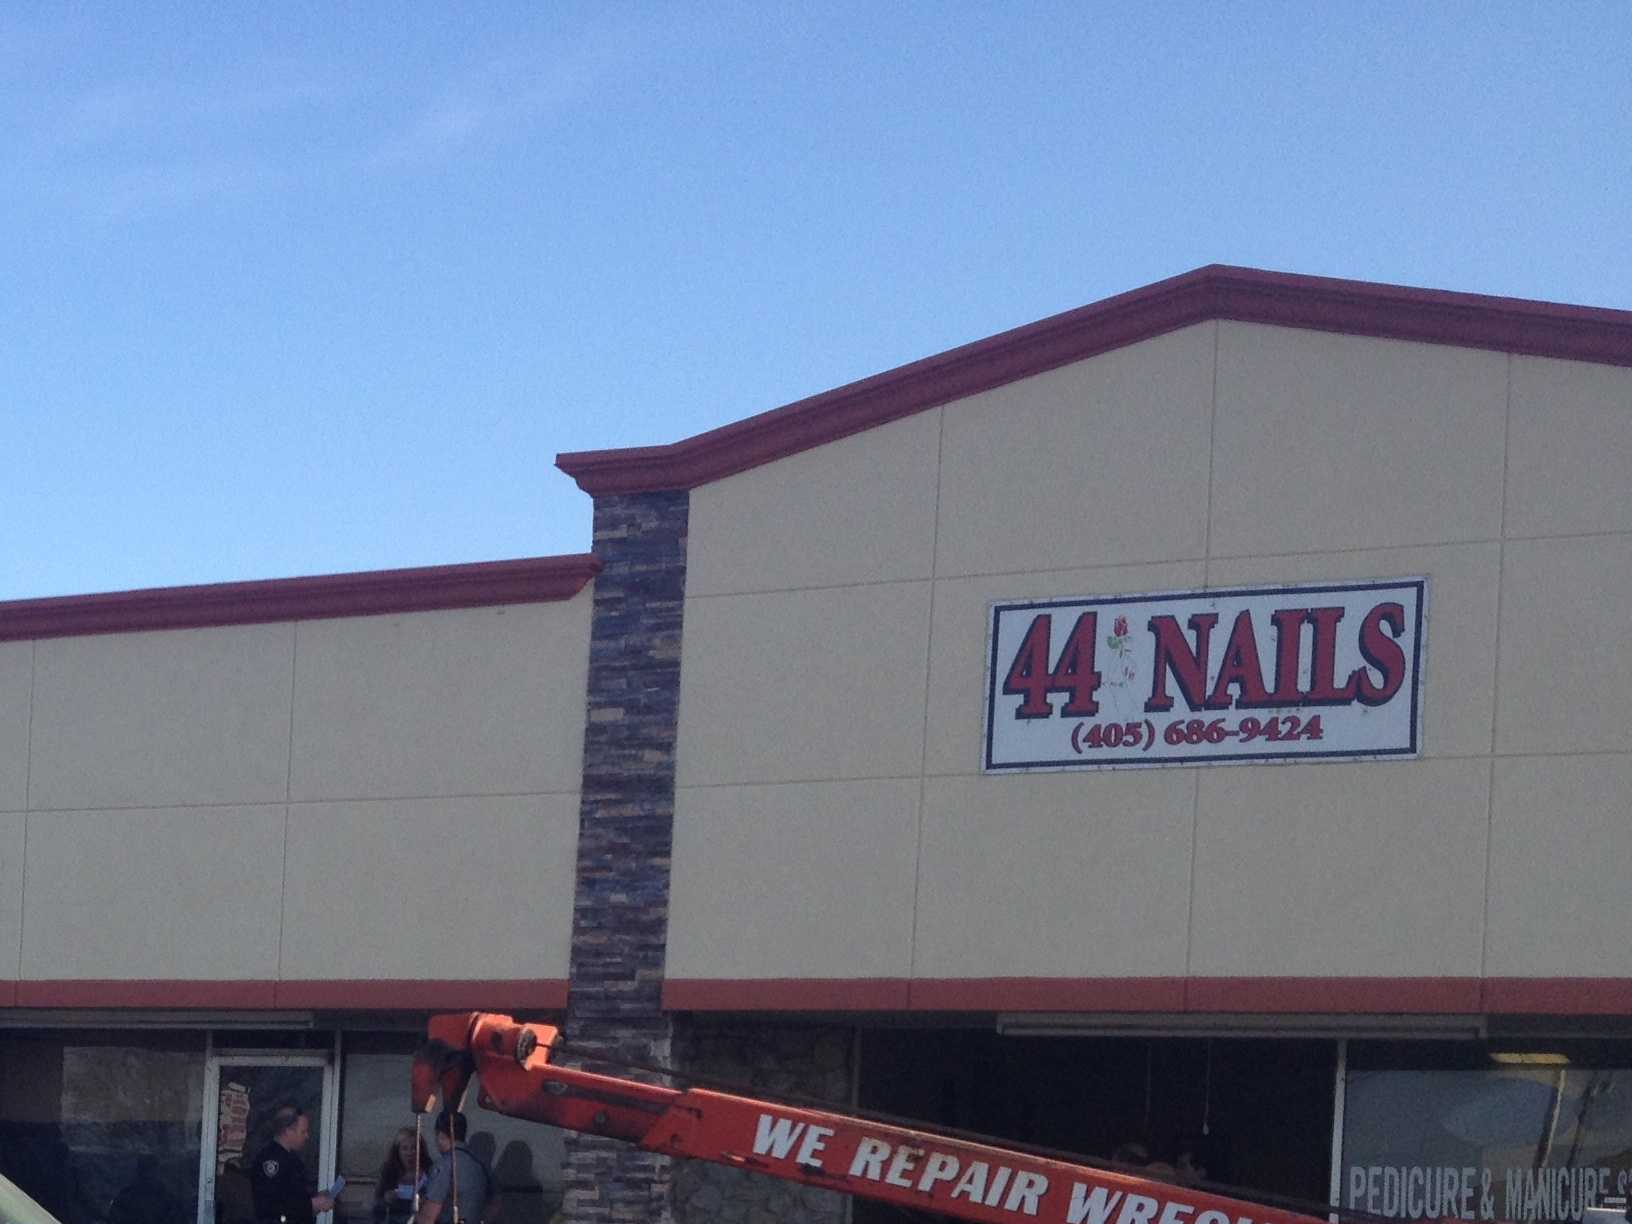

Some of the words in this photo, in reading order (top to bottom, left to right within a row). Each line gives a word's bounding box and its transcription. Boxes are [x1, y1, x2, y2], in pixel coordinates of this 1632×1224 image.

[1002, 610, 1102, 720] 44
[1144, 602, 1406, 712] NAILS
[1071, 719, 1156, 754] (405)
[1164, 715, 1324, 746] 686-9424
[752, 1113, 835, 1168] WE
[848, 1136, 1049, 1215] REPAIR
[1349, 1166, 1475, 1220] PEDICURE
[1480, 1167, 1495, 1220] &
